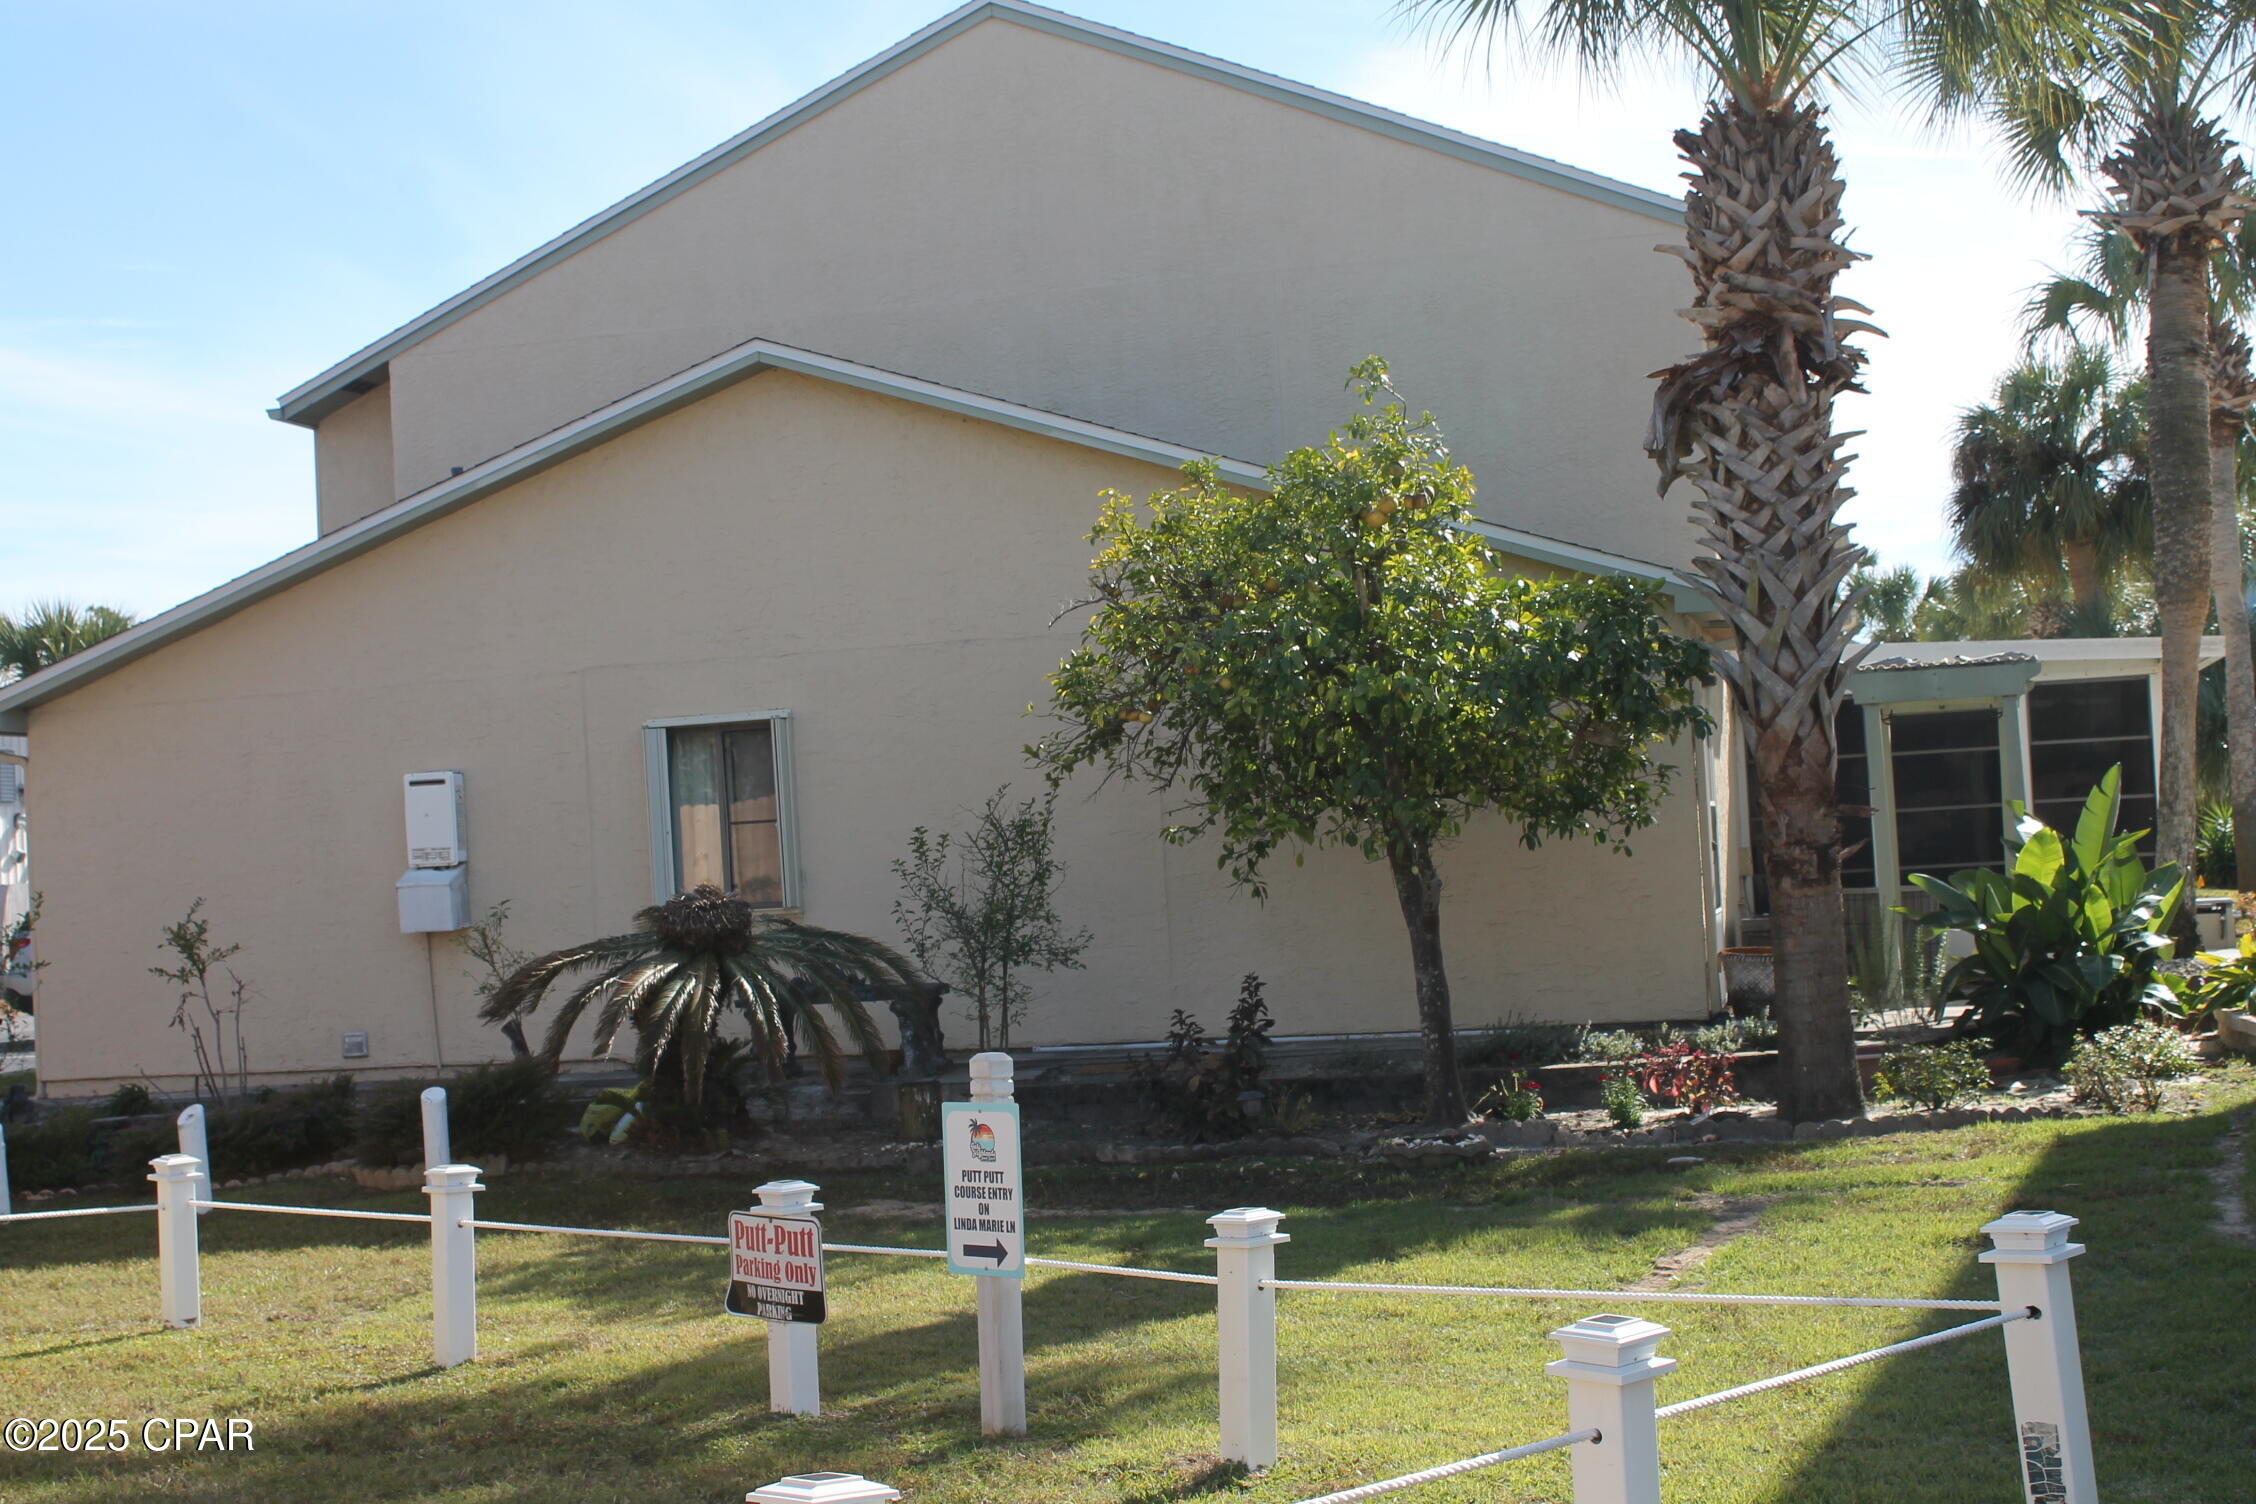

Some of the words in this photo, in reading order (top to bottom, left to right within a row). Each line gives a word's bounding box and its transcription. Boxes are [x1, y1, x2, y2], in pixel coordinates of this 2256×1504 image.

[962, 1170, 981, 1183] PUTT
[984, 1171, 1004, 1184] PUTT
[954, 1186, 986, 1199] COURSE
[988, 1187, 1013, 1200] ENTRY
[978, 1203, 990, 1215] ON
[954, 1217, 977, 1231] LINDA
[979, 1219, 1004, 1232] MARIE
[1006, 1220, 1016, 1233] LN
[734, 1220, 814, 1258] Putt-Putt
[735, 1254, 781, 1283] Parking
[785, 1261, 817, 1287] Only
[747, 1284, 756, 1298] NO
[757, 1286, 804, 1305] OVERNIGHT
[757, 1302, 793, 1320] PARKING
